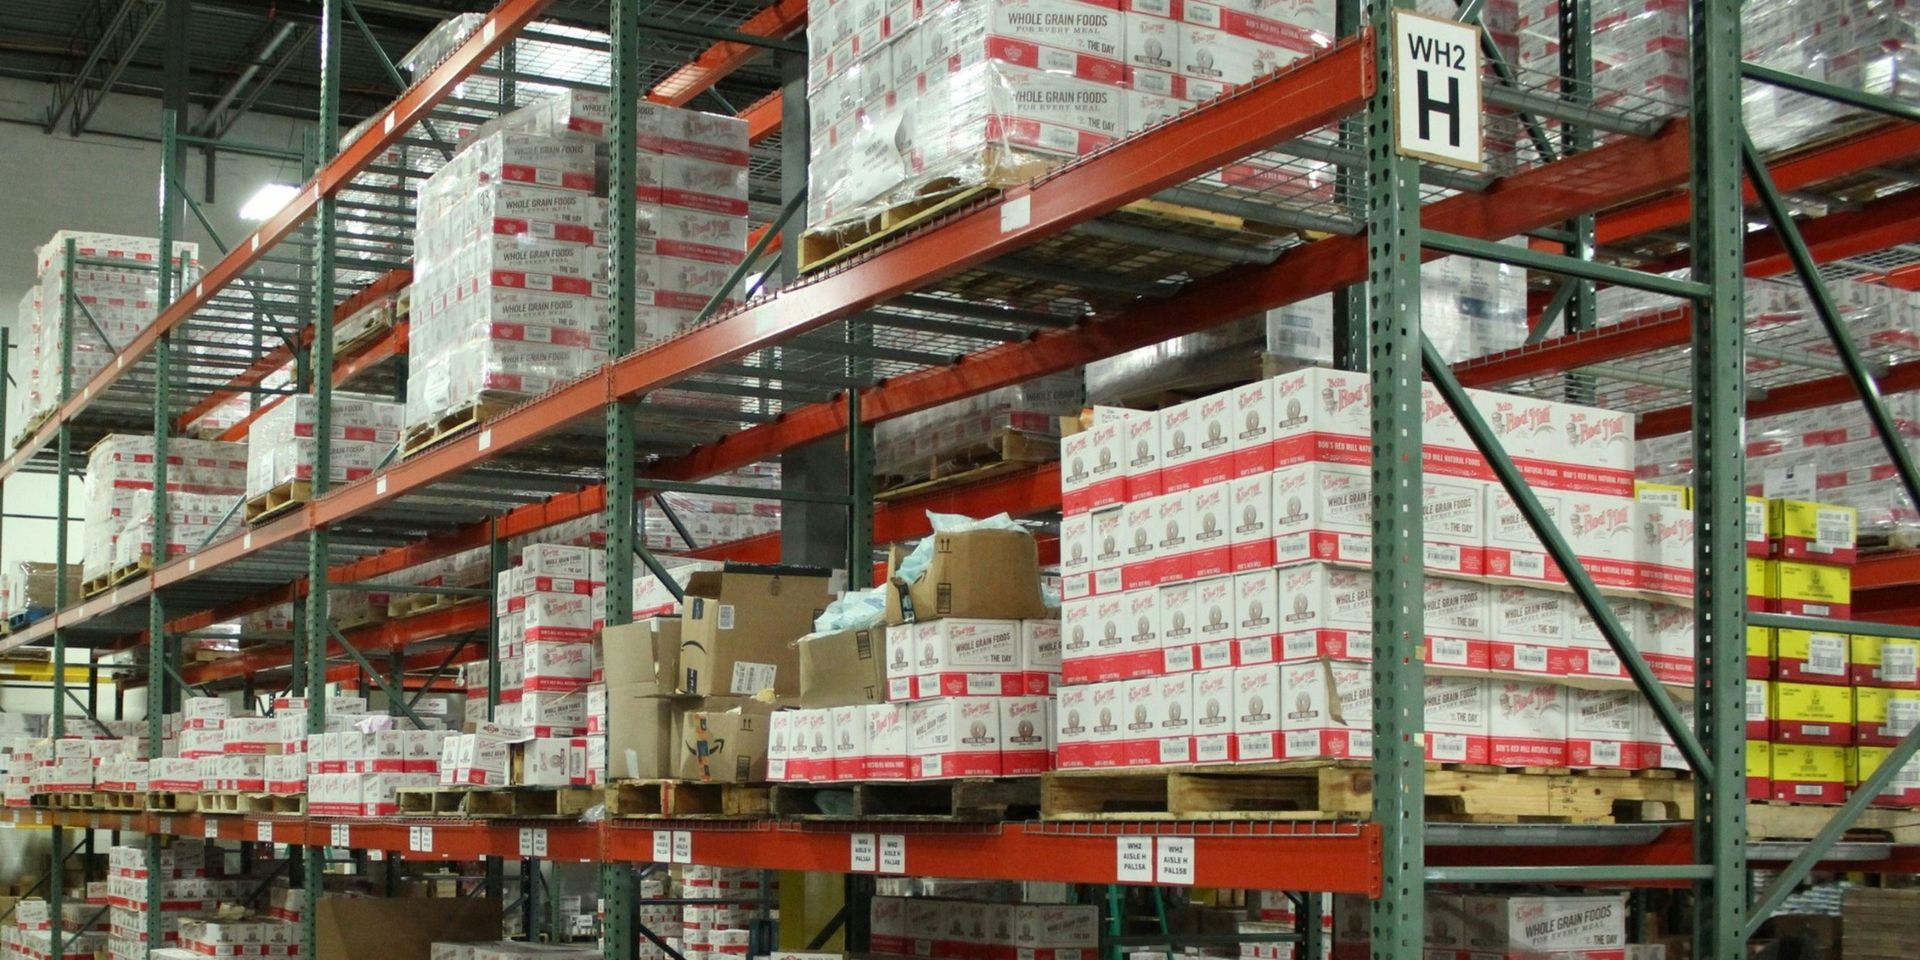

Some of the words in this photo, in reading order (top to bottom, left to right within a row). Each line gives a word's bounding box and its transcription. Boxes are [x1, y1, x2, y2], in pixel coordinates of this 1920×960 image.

[1008, 13, 1042, 25] WHOLE
[1045, 13, 1074, 26] GRAIN
[1076, 14, 1107, 27] FOODS
[1088, 40, 1101, 52] THE
[1101, 42, 1115, 54] DAY
[1408, 33, 1467, 71] WH2
[1046, 91, 1074, 103] GRAIN
[1076, 91, 1107, 104] FOODS
[582, 103, 606, 112] WHOLE
[1417, 69, 1460, 147] H
[1088, 117, 1101, 129] THE
[1102, 119, 1115, 131] DAY
[505, 199, 529, 209] WHOLE
[531, 198, 552, 208] GRAIN
[503, 250, 527, 261] WHOLE
[529, 249, 550, 259] GRAIN
[551, 248, 574, 257] FOODS
[502, 302, 526, 313] WHOLE
[528, 301, 549, 311] GRAIN
[550, 299, 573, 310] FOODS
[1338, 387, 1363, 412] Red
[1506, 409, 1529, 434] Red
[1528, 404, 1551, 432] Mill
[1580, 419, 1602, 445] Red
[1601, 414, 1625, 441] Mill
[1318, 440, 1331, 450] BOB'S
[1334, 442, 1345, 451] RED
[1346, 443, 1357, 452] MILL
[1431, 453, 1443, 462] MILL
[1444, 455, 1464, 466] NATURAL
[1465, 458, 1480, 467] FOODS
[1524, 466, 1543, 475] NATURAL
[1544, 468, 1558, 477] FOODS
[1563, 470, 1577, 479] BOB'S
[1578, 472, 1587, 480] RED
[1587, 473, 1598, 481] MILL
[1598, 474, 1616, 483] NATURAL
[1328, 494, 1347, 507] WHOLE
[1350, 491, 1367, 503] GRAIN
[1435, 502, 1452, 514] GRAIN
[1453, 498, 1472, 511] FOODS
[1584, 512, 1606, 536] Red
[1605, 506, 1628, 531] Mill
[1450, 523, 1460, 532] THE
[1461, 524, 1472, 533] DAY
[1601, 567, 1620, 576] NATURAL
[1336, 592, 1355, 605] WHOLE
[1442, 596, 1459, 609] GRAIN
[1460, 592, 1478, 605] FOODS
[1505, 607, 1524, 619] WHOLE
[1524, 604, 1540, 615] GRAIN
[1541, 600, 1559, 612] FOODS
[1457, 617, 1467, 627] THE
[1468, 618, 1479, 628] DAY
[1538, 624, 1548, 633] THE
[1549, 625, 1559, 634] DAY
[955, 641, 974, 652] WHOLE
[975, 637, 992, 648] GRAIN
[993, 632, 1011, 645] FOODS
[1038, 641, 1056, 652] WHOLE
[990, 654, 1001, 663] THE
[1002, 655, 1012, 663] DAY
[1442, 691, 1460, 704] GRAIN
[1460, 686, 1478, 700] FOODS
[1582, 704, 1600, 716] WHOLE
[1456, 712, 1466, 722] THE
[1467, 713, 1478, 722] DAY
[1495, 744, 1510, 752] BOB'S
[1511, 744, 1519, 752] RED
[1520, 745, 1530, 753] MILL
[1531, 746, 1550, 754] NATURAL
[1168, 846, 1183, 854] WH2
[1163, 856, 1181, 864] AISLE
[1164, 866, 1187, 874] PAL15B
[1525, 920, 1556, 939] WHOLE
[1556, 912, 1583, 931] GRAIN
[1584, 904, 1612, 923] FOODS
[1593, 934, 1605, 945] THE
[1606, 934, 1618, 945] DAY
